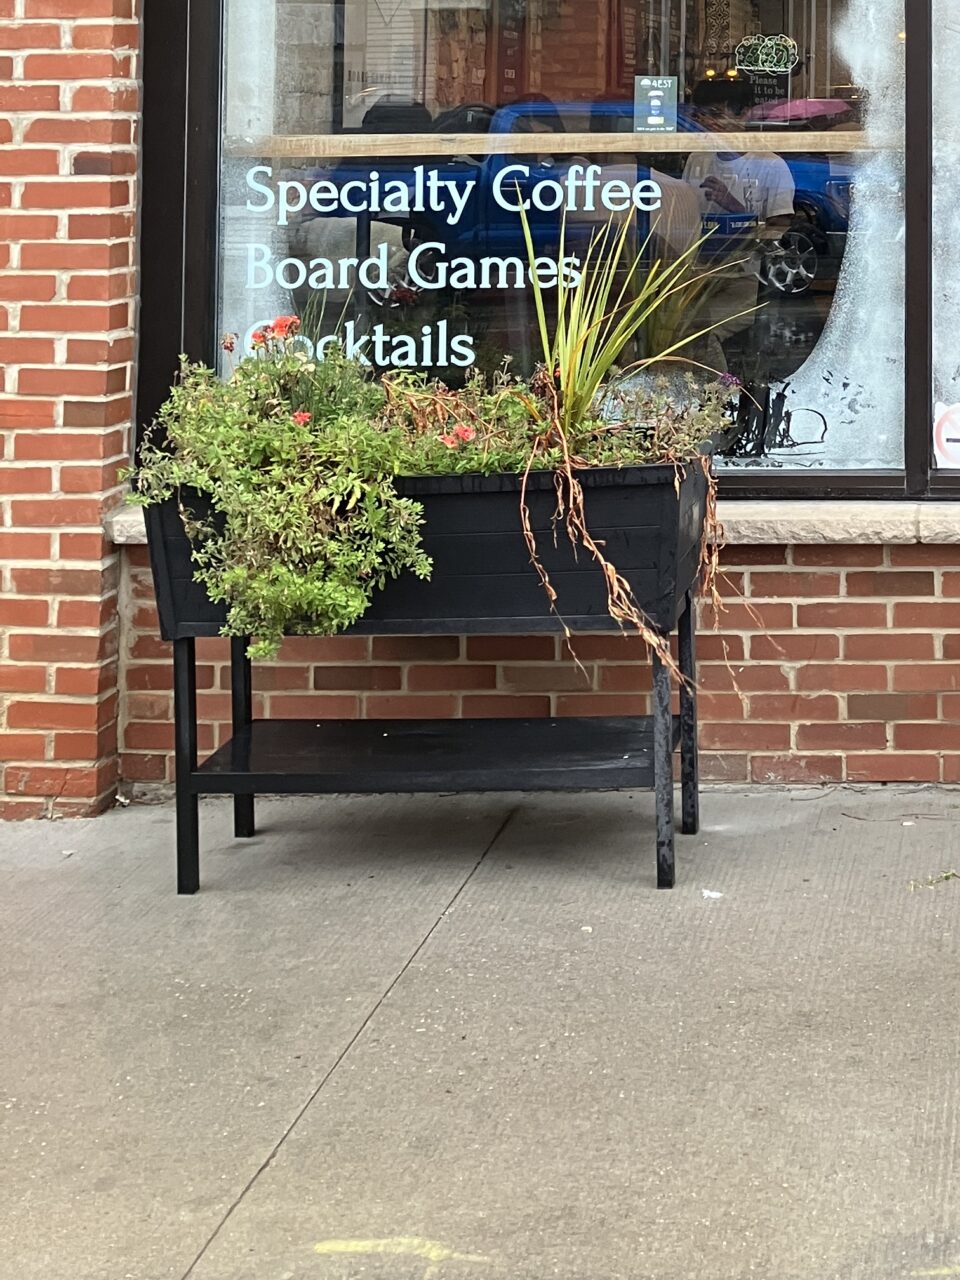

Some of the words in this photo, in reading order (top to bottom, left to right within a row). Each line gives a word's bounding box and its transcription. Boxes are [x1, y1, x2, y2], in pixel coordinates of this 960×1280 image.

[748, 75, 778, 86] Please
[752, 85, 762, 95] it
[763, 85, 774, 95] to
[775, 86, 785, 96] be
[754, 95, 779, 105] eated
[245, 164, 476, 226] Specialty
[492, 164, 662, 212] Coffee
[244, 242, 390, 290] Board
[407, 241, 583, 290] Games
